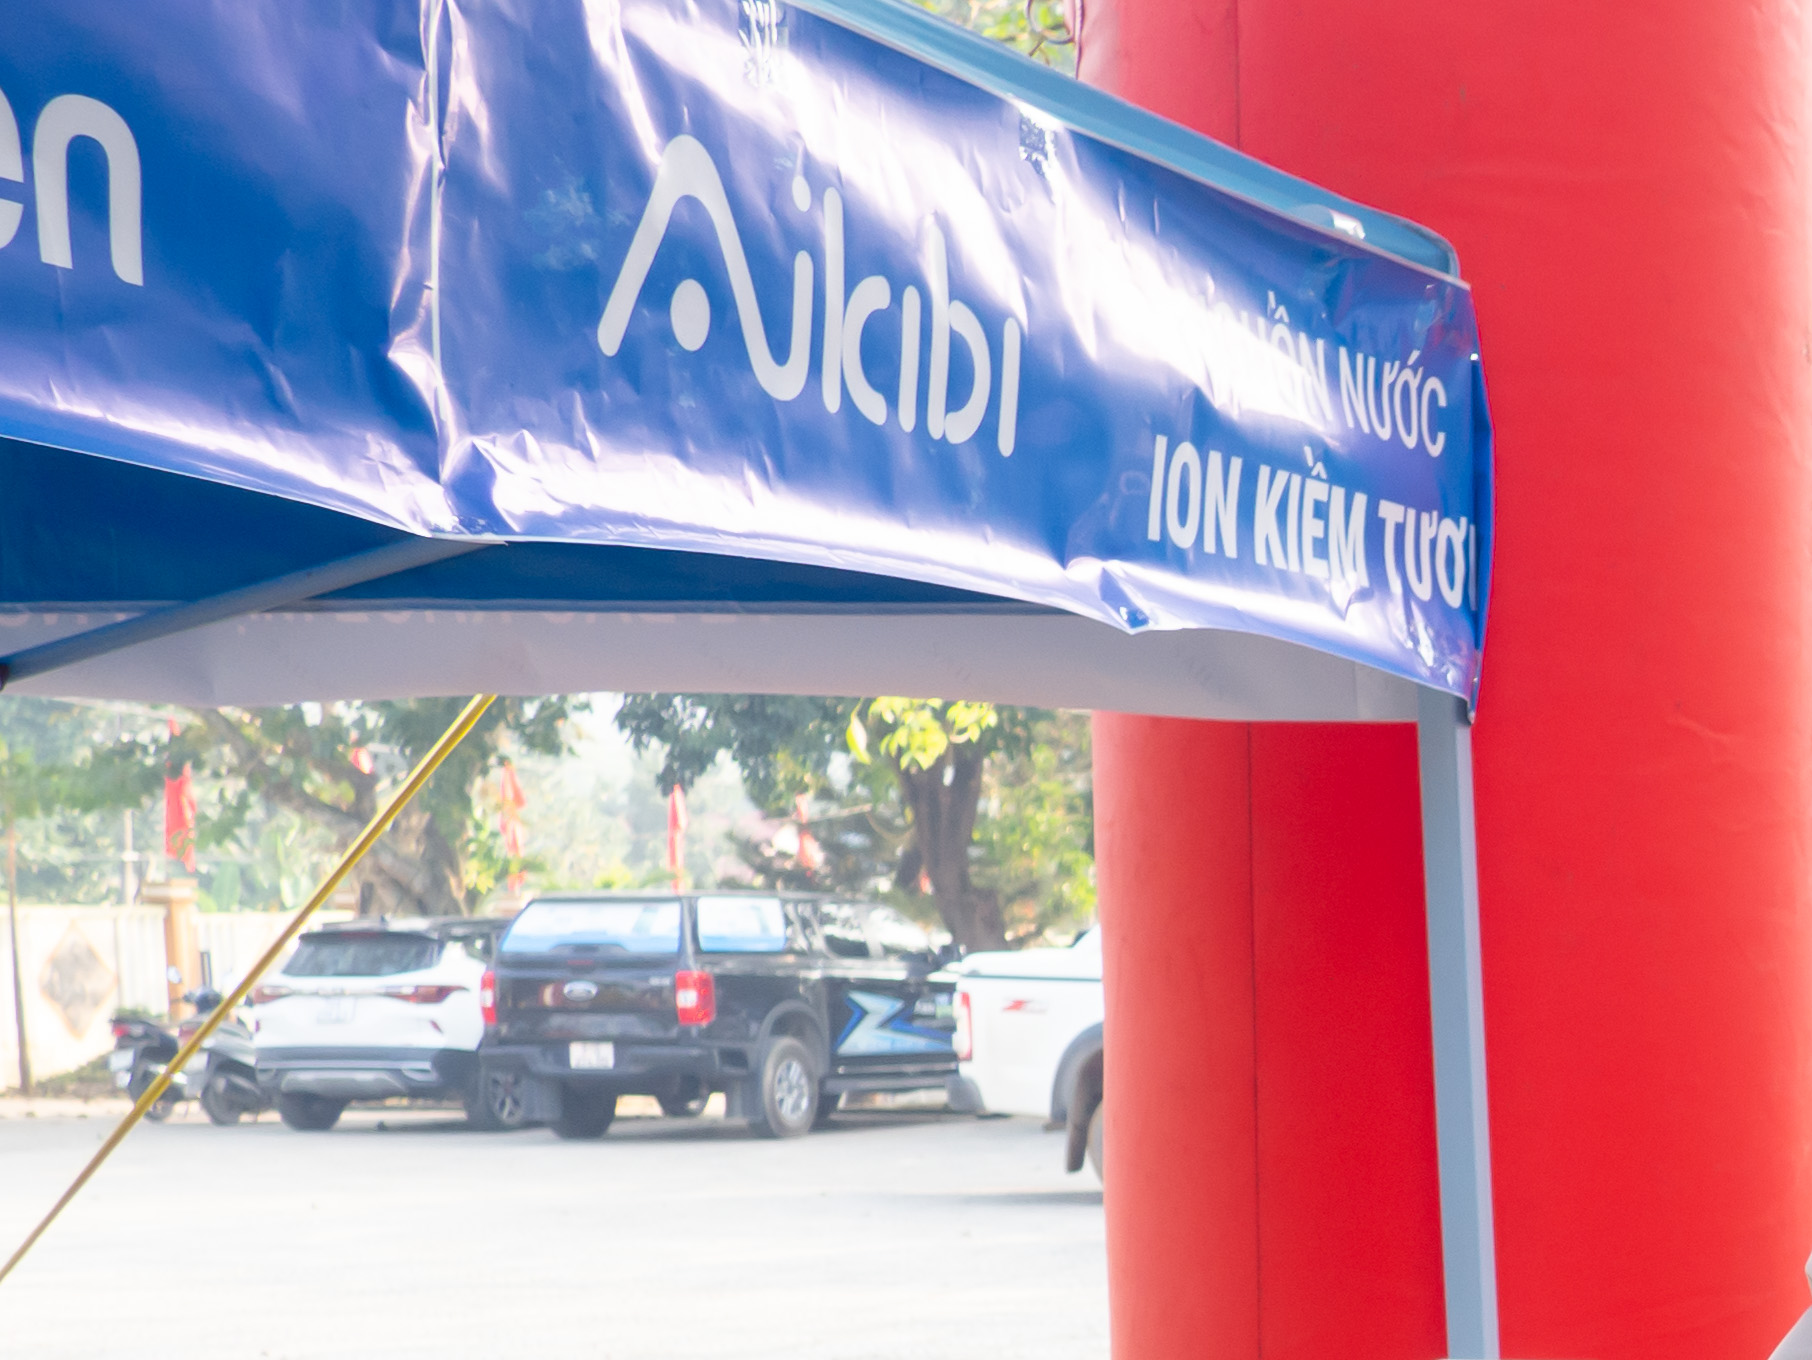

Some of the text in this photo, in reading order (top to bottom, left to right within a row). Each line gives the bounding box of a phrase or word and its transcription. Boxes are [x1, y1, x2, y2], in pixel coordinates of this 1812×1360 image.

[597, 134, 1020, 457] Aikibi
[1339, 349, 1447, 458] NƯỚC
[1147, 434, 1478, 611] ION KIỀM TƯƠI
